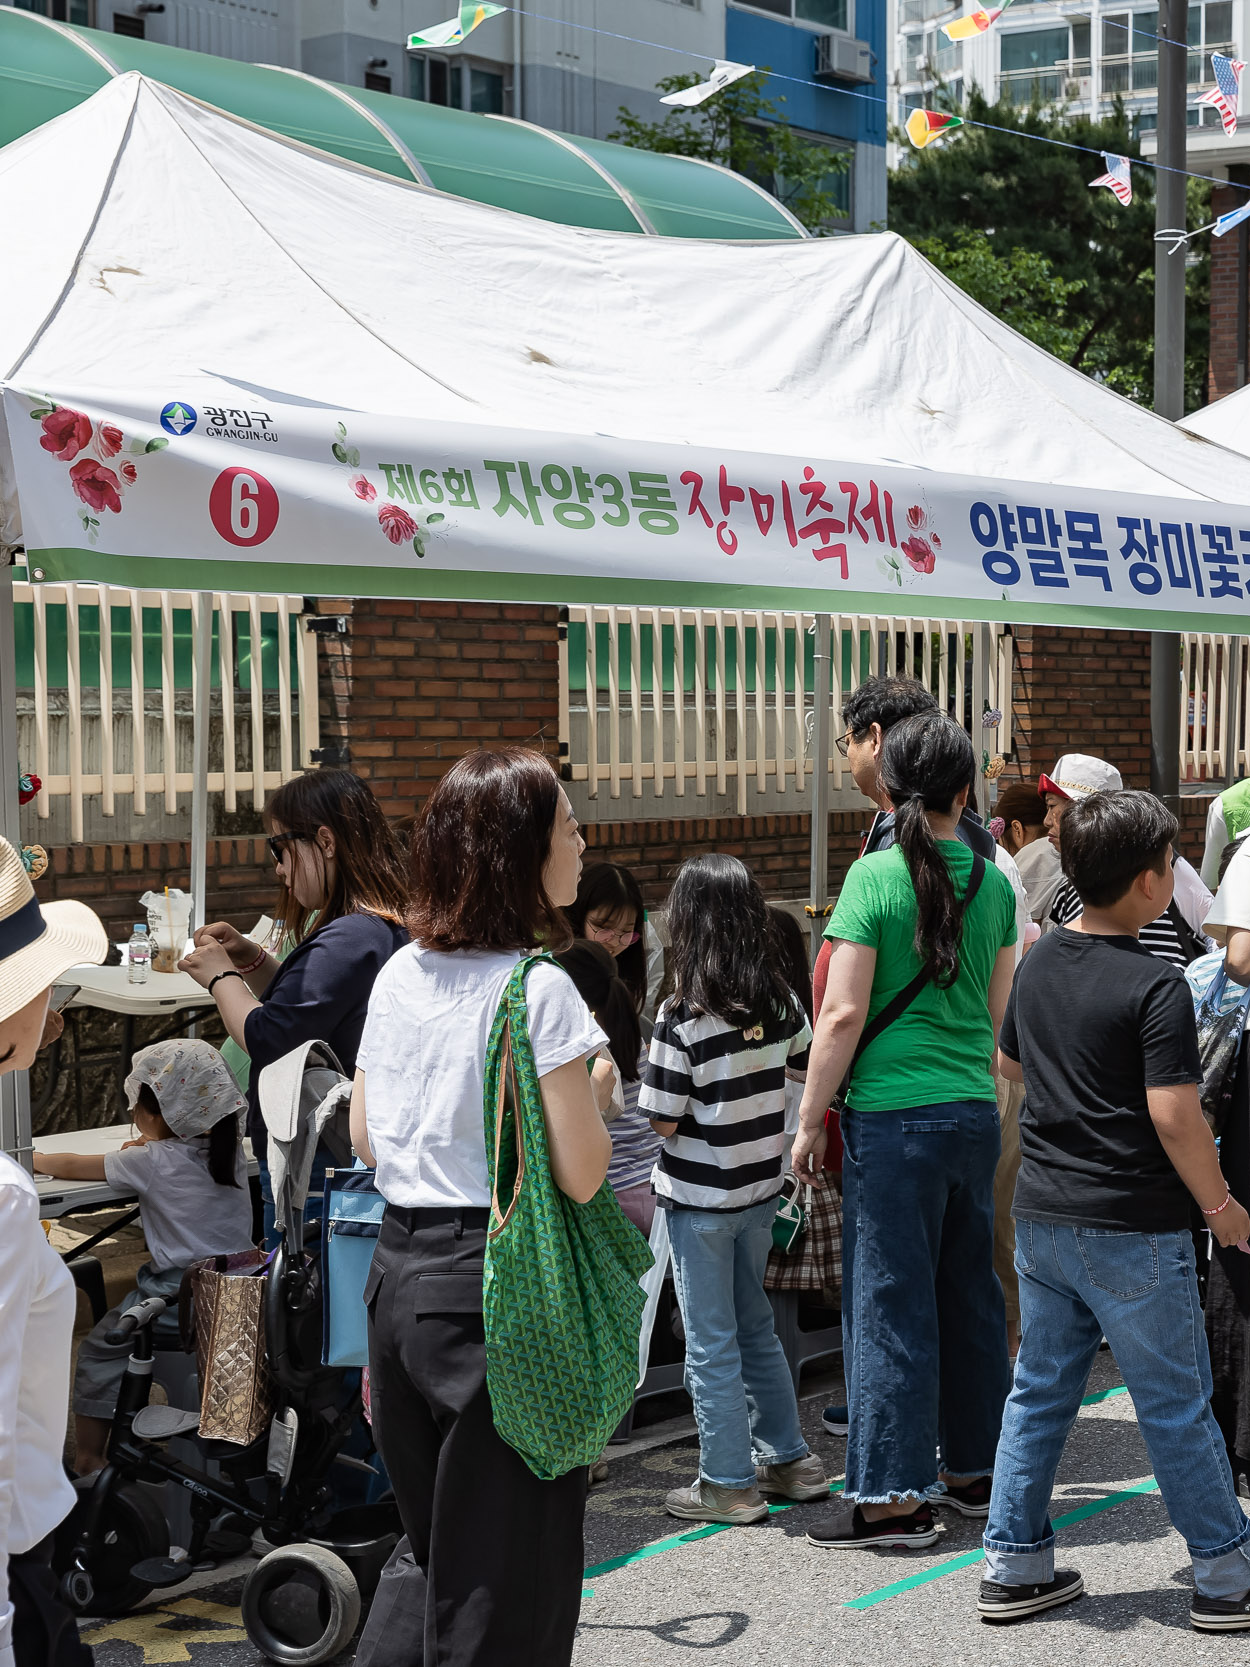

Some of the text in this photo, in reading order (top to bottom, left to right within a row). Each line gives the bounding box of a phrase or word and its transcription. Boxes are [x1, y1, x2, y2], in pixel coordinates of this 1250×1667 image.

[203, 406, 274, 428] 광진구
[205, 426, 279, 443] GWANGJIN-GU
[231, 474, 259, 539] 6
[377, 463, 481, 510] 제6회
[483, 459, 680, 535] 자양3동
[680, 464, 897, 580] 장미축제
[969, 501, 1113, 592] 양말목
